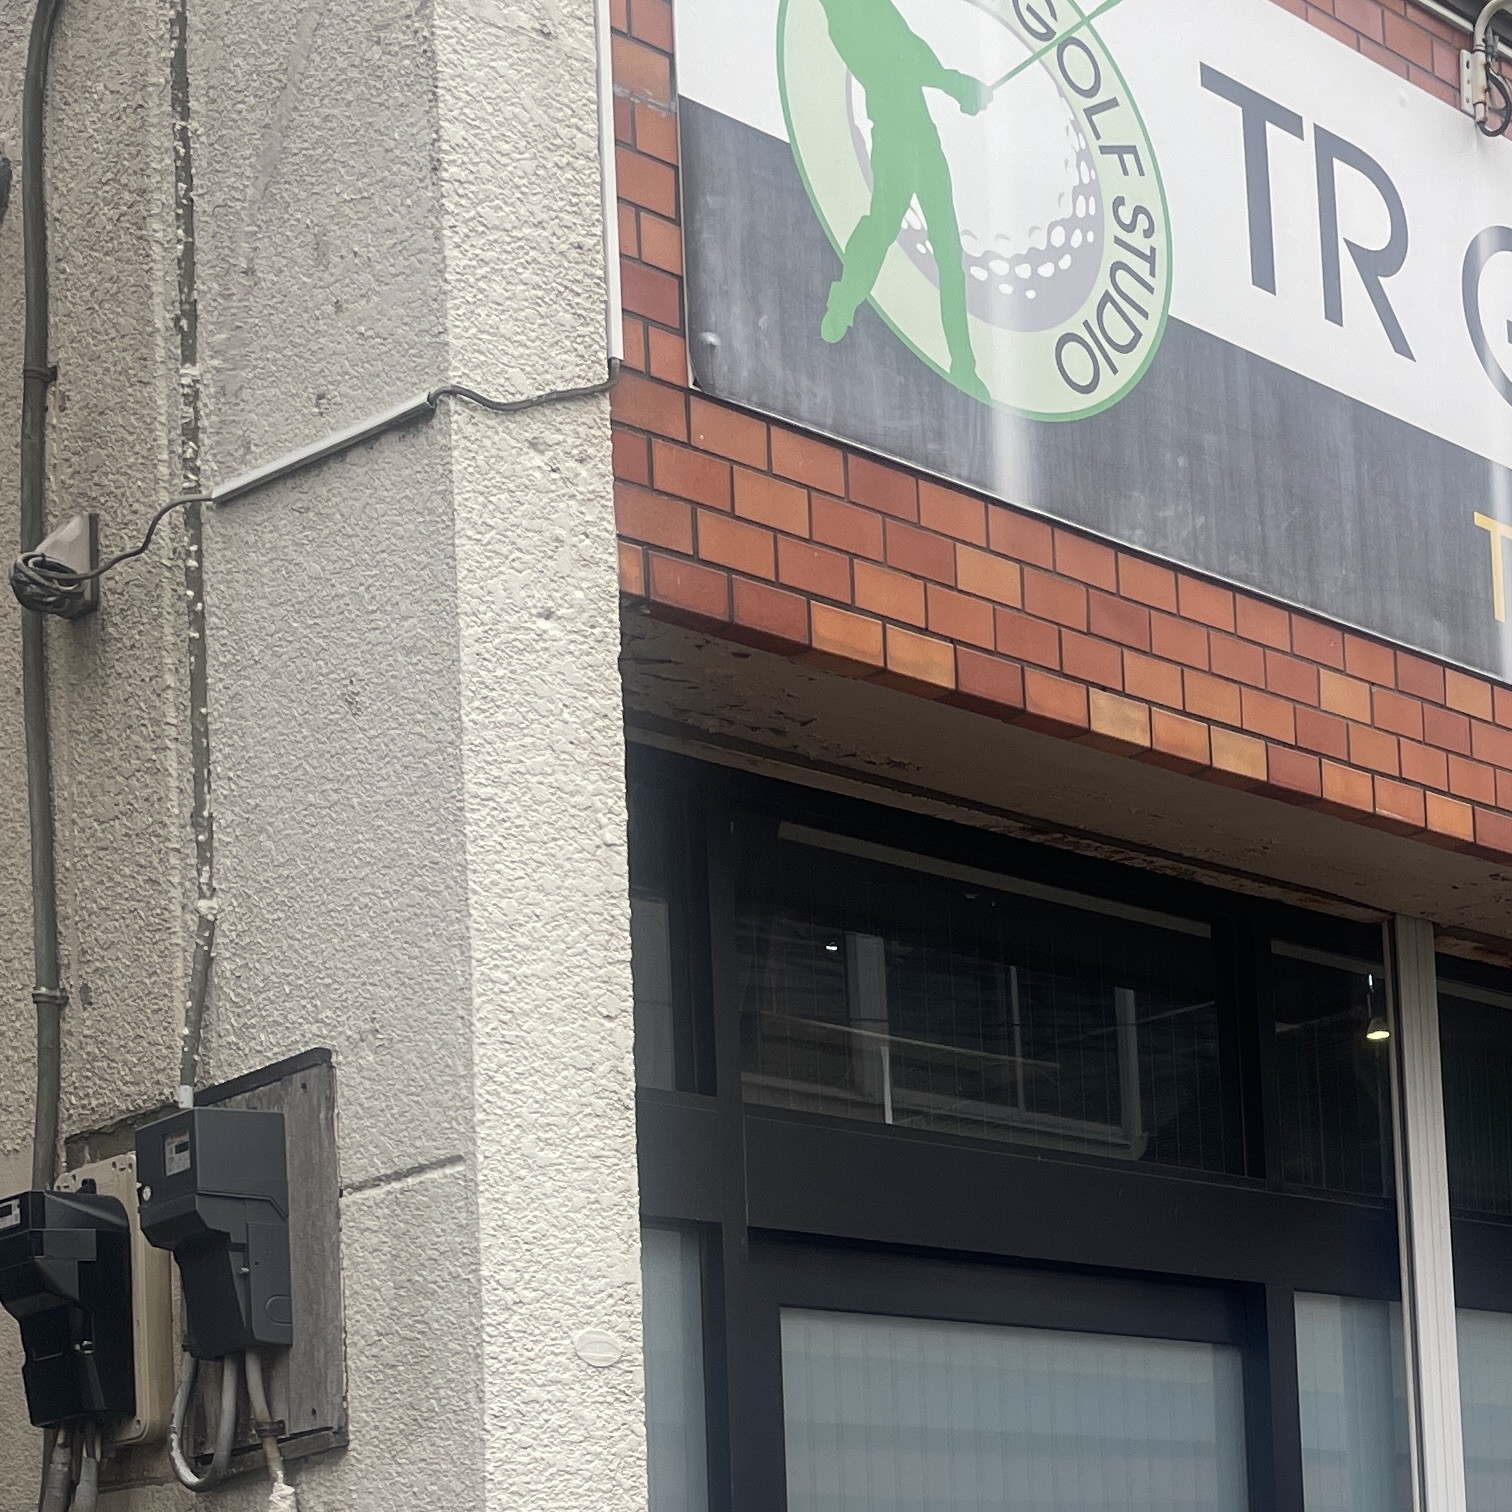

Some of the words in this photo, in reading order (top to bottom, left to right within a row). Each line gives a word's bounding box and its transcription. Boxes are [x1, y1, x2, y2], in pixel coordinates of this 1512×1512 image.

[1012, 0, 1145, 179] GOLF
[1055, 195, 1157, 395] STUDIO
[1199, 60, 1417, 363] TR
